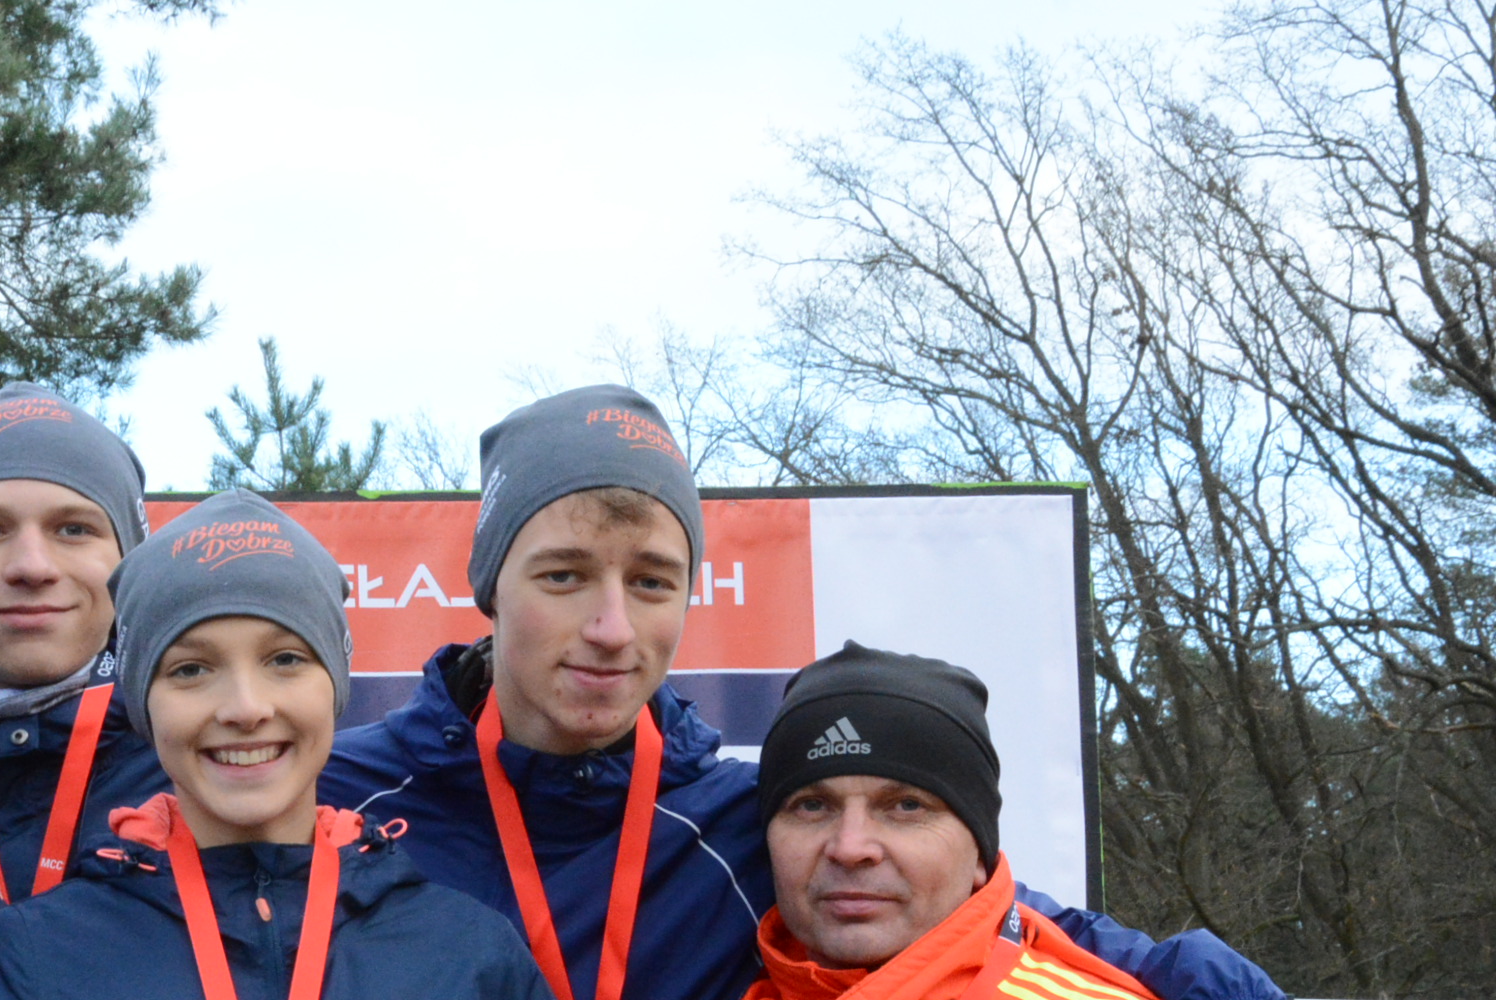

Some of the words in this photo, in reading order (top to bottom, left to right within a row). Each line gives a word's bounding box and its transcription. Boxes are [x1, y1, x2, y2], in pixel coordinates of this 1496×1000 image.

[171, 520, 281, 559] #Biegam
[807, 740, 872, 760] adidas
[40, 857, 64, 871] MCC
